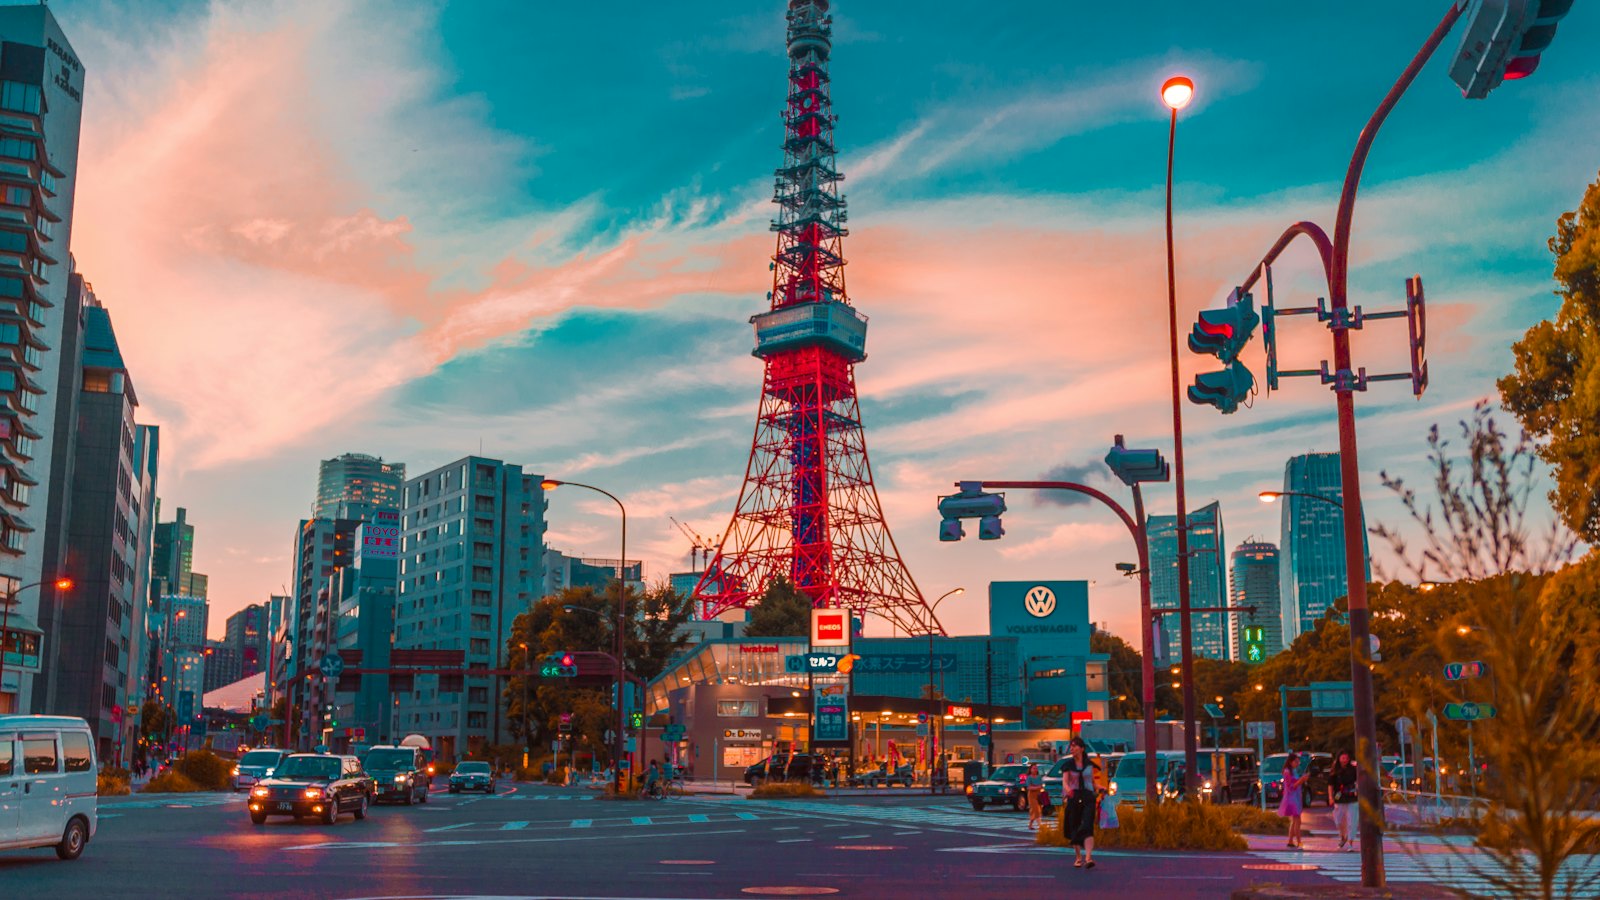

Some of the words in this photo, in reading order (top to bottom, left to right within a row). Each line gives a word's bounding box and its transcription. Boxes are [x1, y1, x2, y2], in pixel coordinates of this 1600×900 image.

[365, 526, 399, 537] TOYO
[1006, 624, 1077, 634] VOLKSWAGEN
[809, 656, 836, 667] セルフ
[738, 730, 760, 738] Drive
